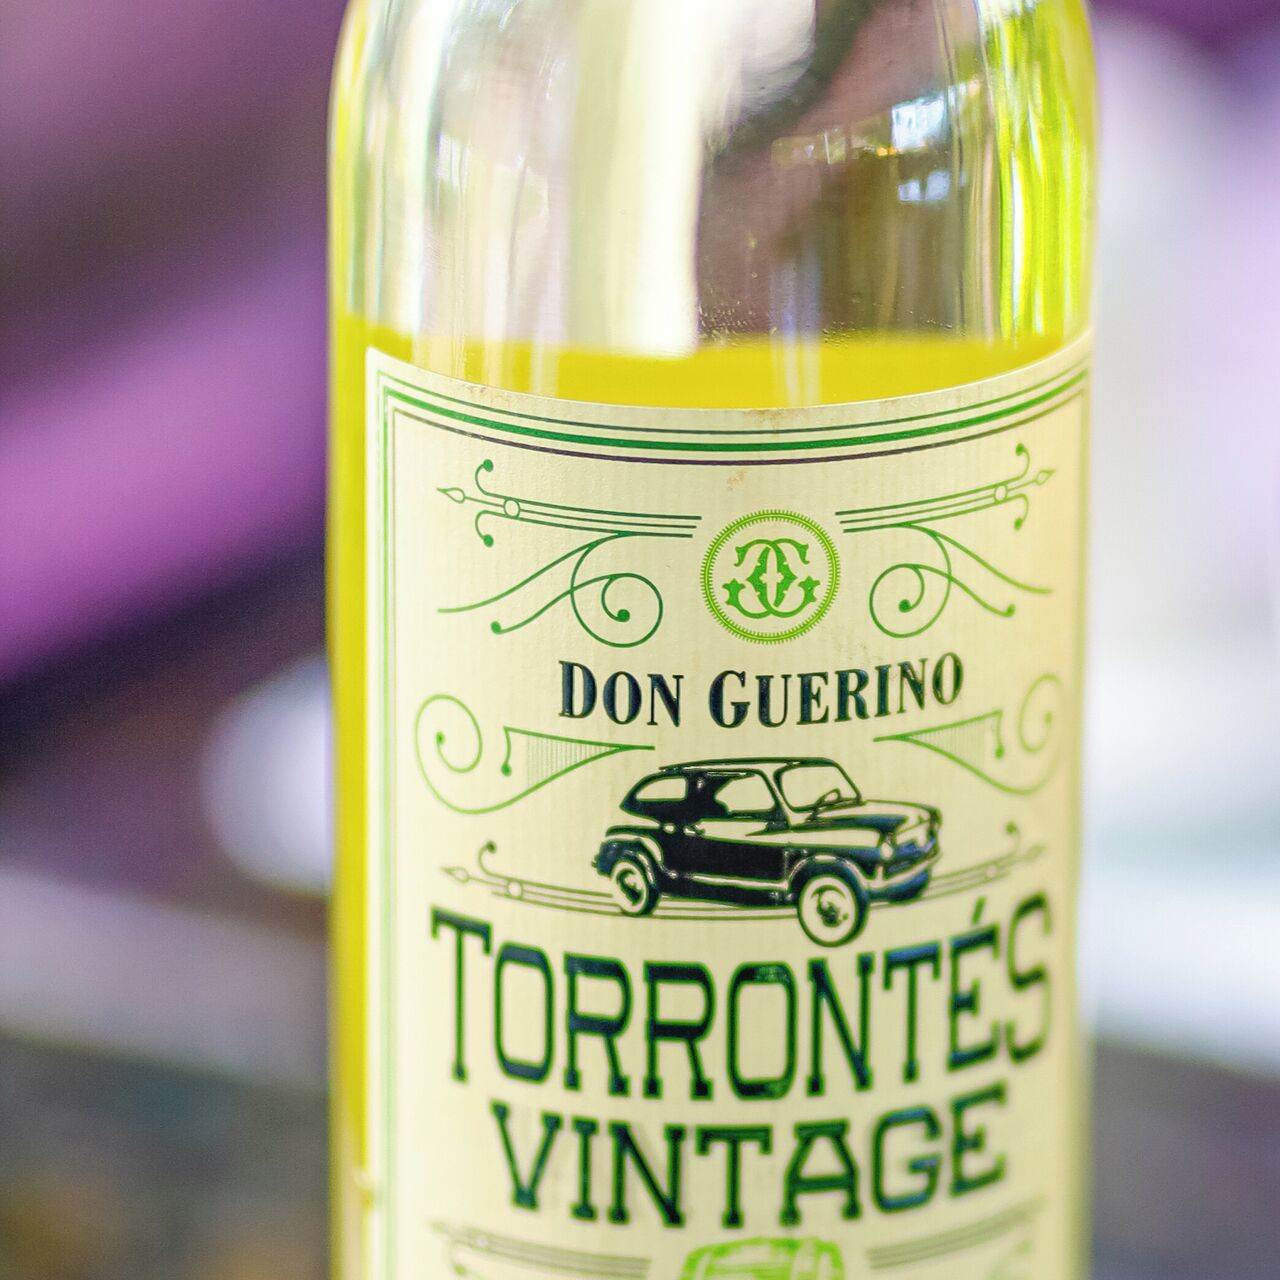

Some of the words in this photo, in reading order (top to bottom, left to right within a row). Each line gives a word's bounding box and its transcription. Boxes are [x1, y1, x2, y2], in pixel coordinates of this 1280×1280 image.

[557, 660, 685, 728] DON
[707, 651, 965, 729] GUERINO
[429, 889, 1055, 1102] TORRONTÉS
[489, 1083, 1008, 1230] VINTAGE
